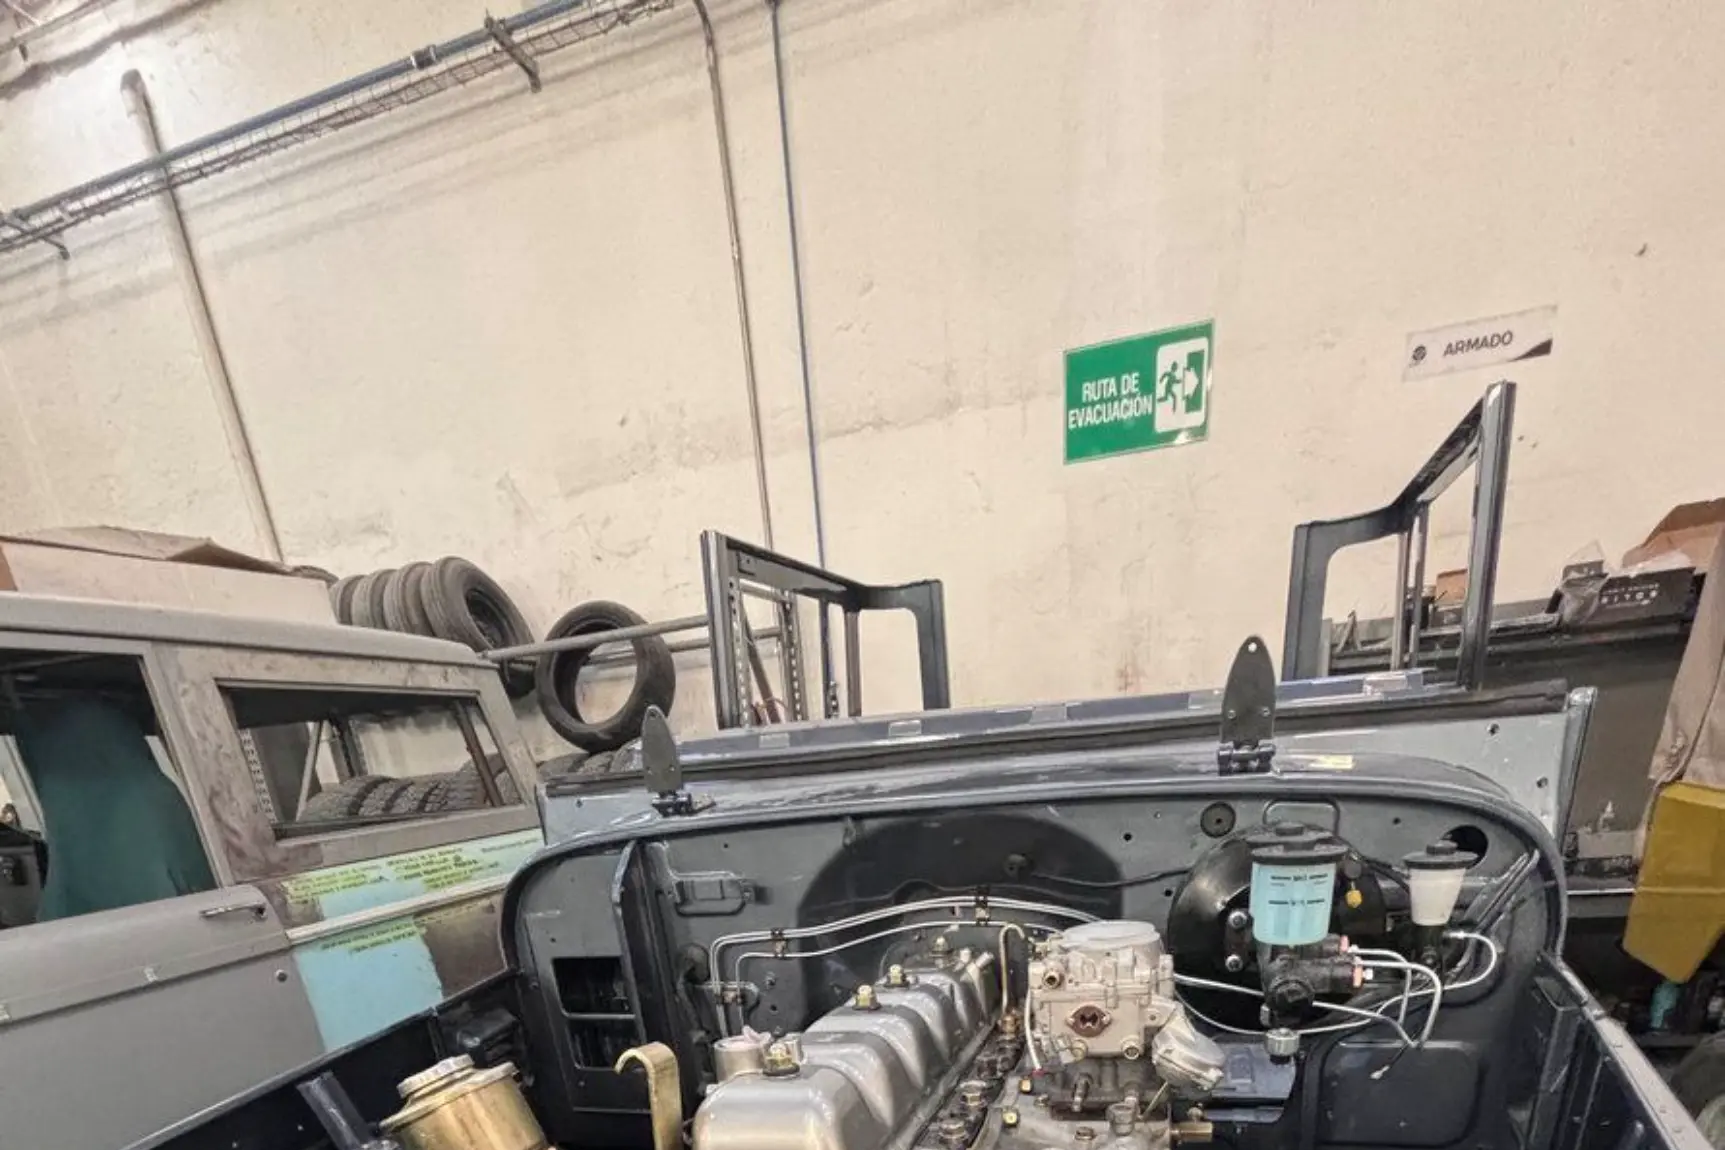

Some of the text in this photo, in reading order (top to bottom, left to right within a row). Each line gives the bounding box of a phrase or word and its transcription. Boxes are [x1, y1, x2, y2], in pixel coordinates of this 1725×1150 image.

[1443, 330, 1513, 357] ARMADO
[1082, 371, 1140, 402] RUTA DE
